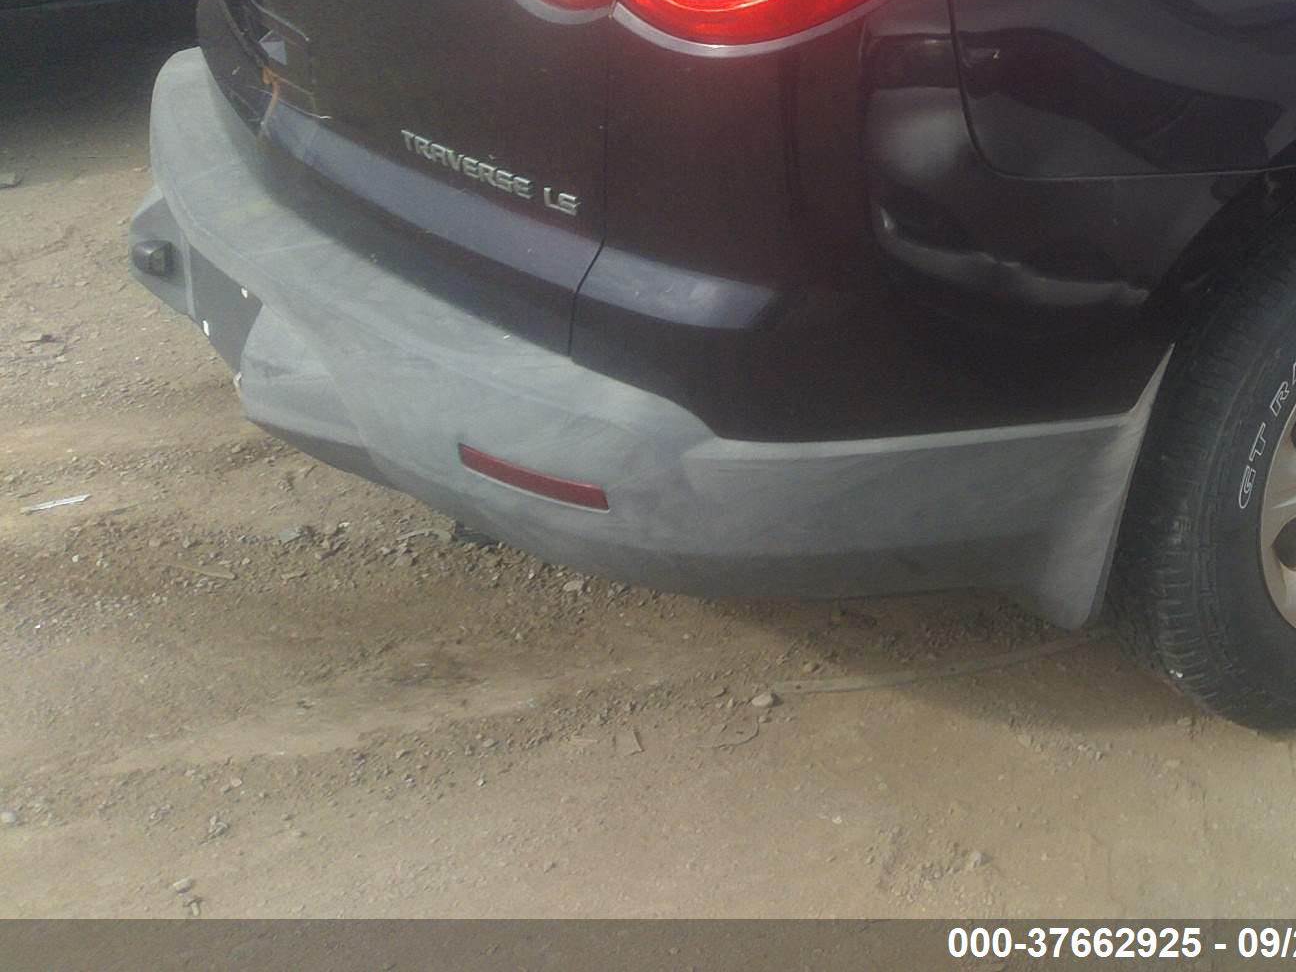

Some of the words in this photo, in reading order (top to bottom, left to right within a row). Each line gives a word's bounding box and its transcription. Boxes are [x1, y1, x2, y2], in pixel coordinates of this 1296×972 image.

[401, 129, 533, 200] TRAVERSE
[543, 187, 582, 216] LS
[1238, 422, 1267, 510] GT
